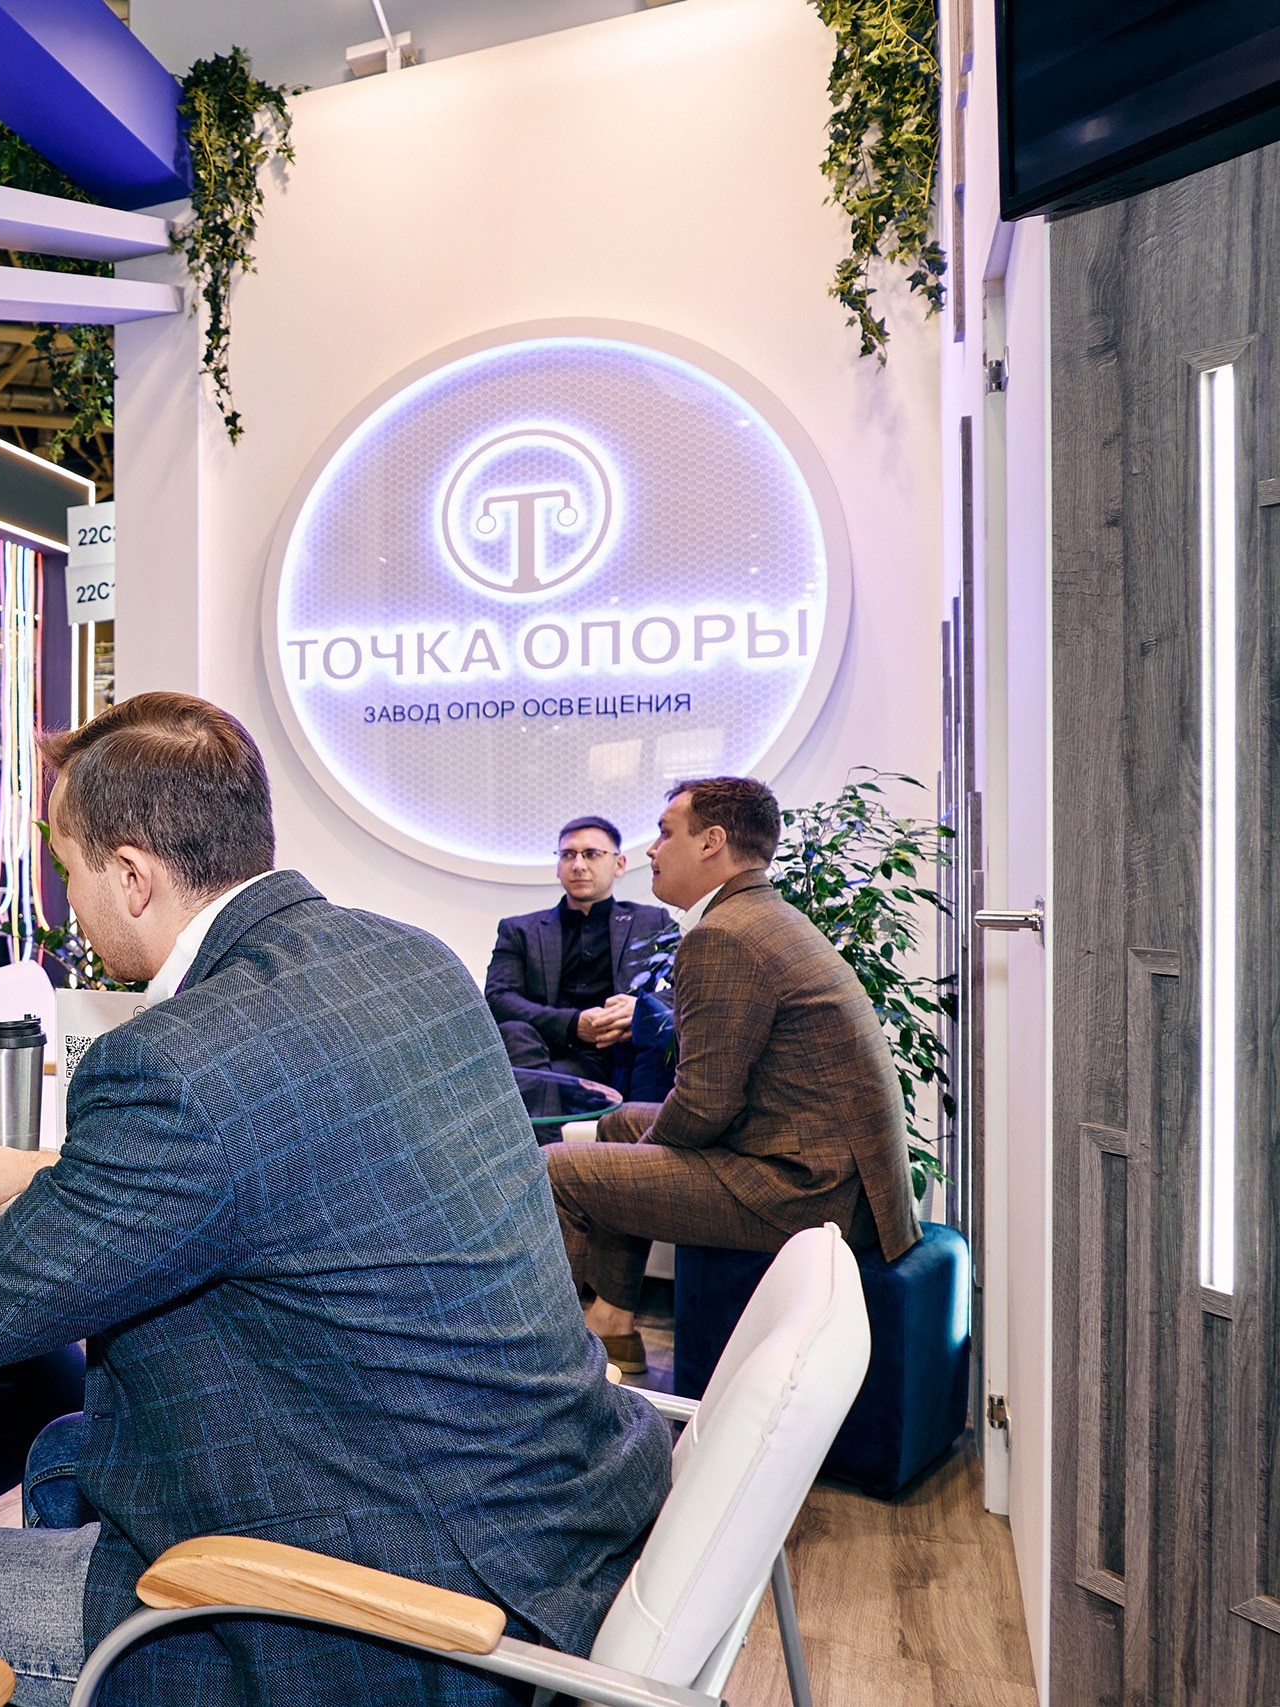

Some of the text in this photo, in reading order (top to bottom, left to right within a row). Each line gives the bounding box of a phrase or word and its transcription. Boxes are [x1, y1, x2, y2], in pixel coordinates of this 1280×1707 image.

[78, 525, 115, 546] 22C
[76, 582, 115, 604] 22C
[287, 608, 809, 681] ТОЧКА ОПОРЫ
[363, 693, 692, 725] ЗАВОД ОПОР ОСВЕЩЕНИЯ
